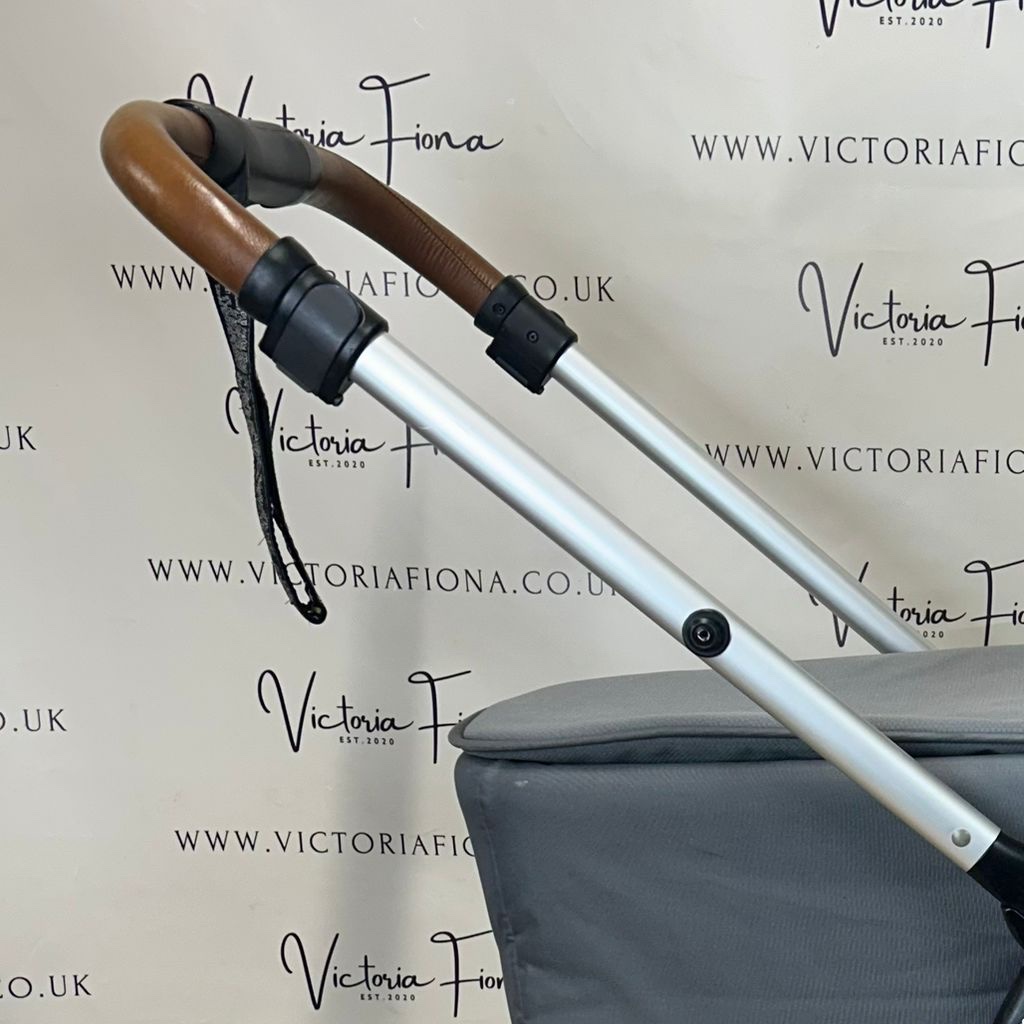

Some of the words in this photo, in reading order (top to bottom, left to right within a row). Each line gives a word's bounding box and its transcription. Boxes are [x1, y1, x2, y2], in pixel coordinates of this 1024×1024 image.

[879, 16, 943, 26] EST.2020
[359, 73, 504, 185] Fiona
[798, 261, 967, 357] Victoria
[882, 337, 943, 346] EST.2020
[308, 459, 366, 468] EST.2020
[258, 669, 414, 752] Victoria
[339, 736, 395, 745] EST.2020
[281, 932, 435, 1010] Victoria
[360, 993, 416, 1001] EST.2020
